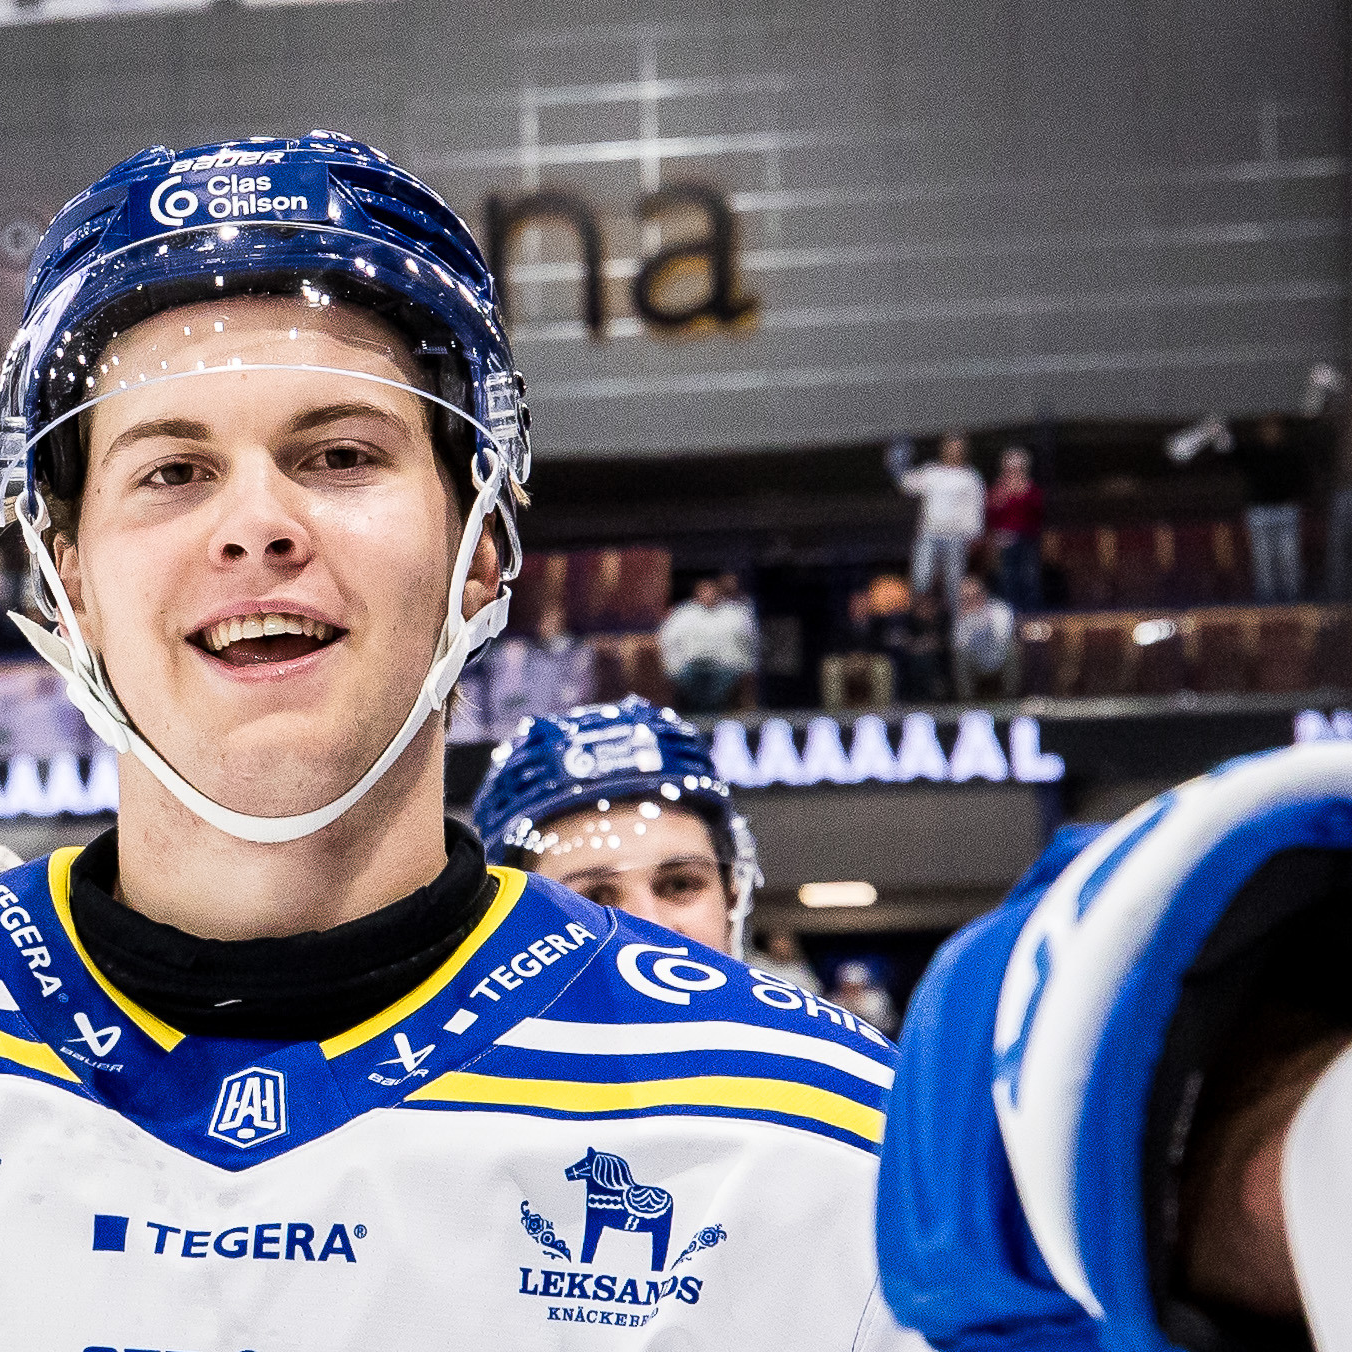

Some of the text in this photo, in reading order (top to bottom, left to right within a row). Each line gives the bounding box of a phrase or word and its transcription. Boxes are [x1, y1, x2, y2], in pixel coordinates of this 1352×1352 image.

[207, 173, 272, 196] Clas
[208, 193, 309, 219] Ohlson
[469, 921, 597, 1002] TEGERA
